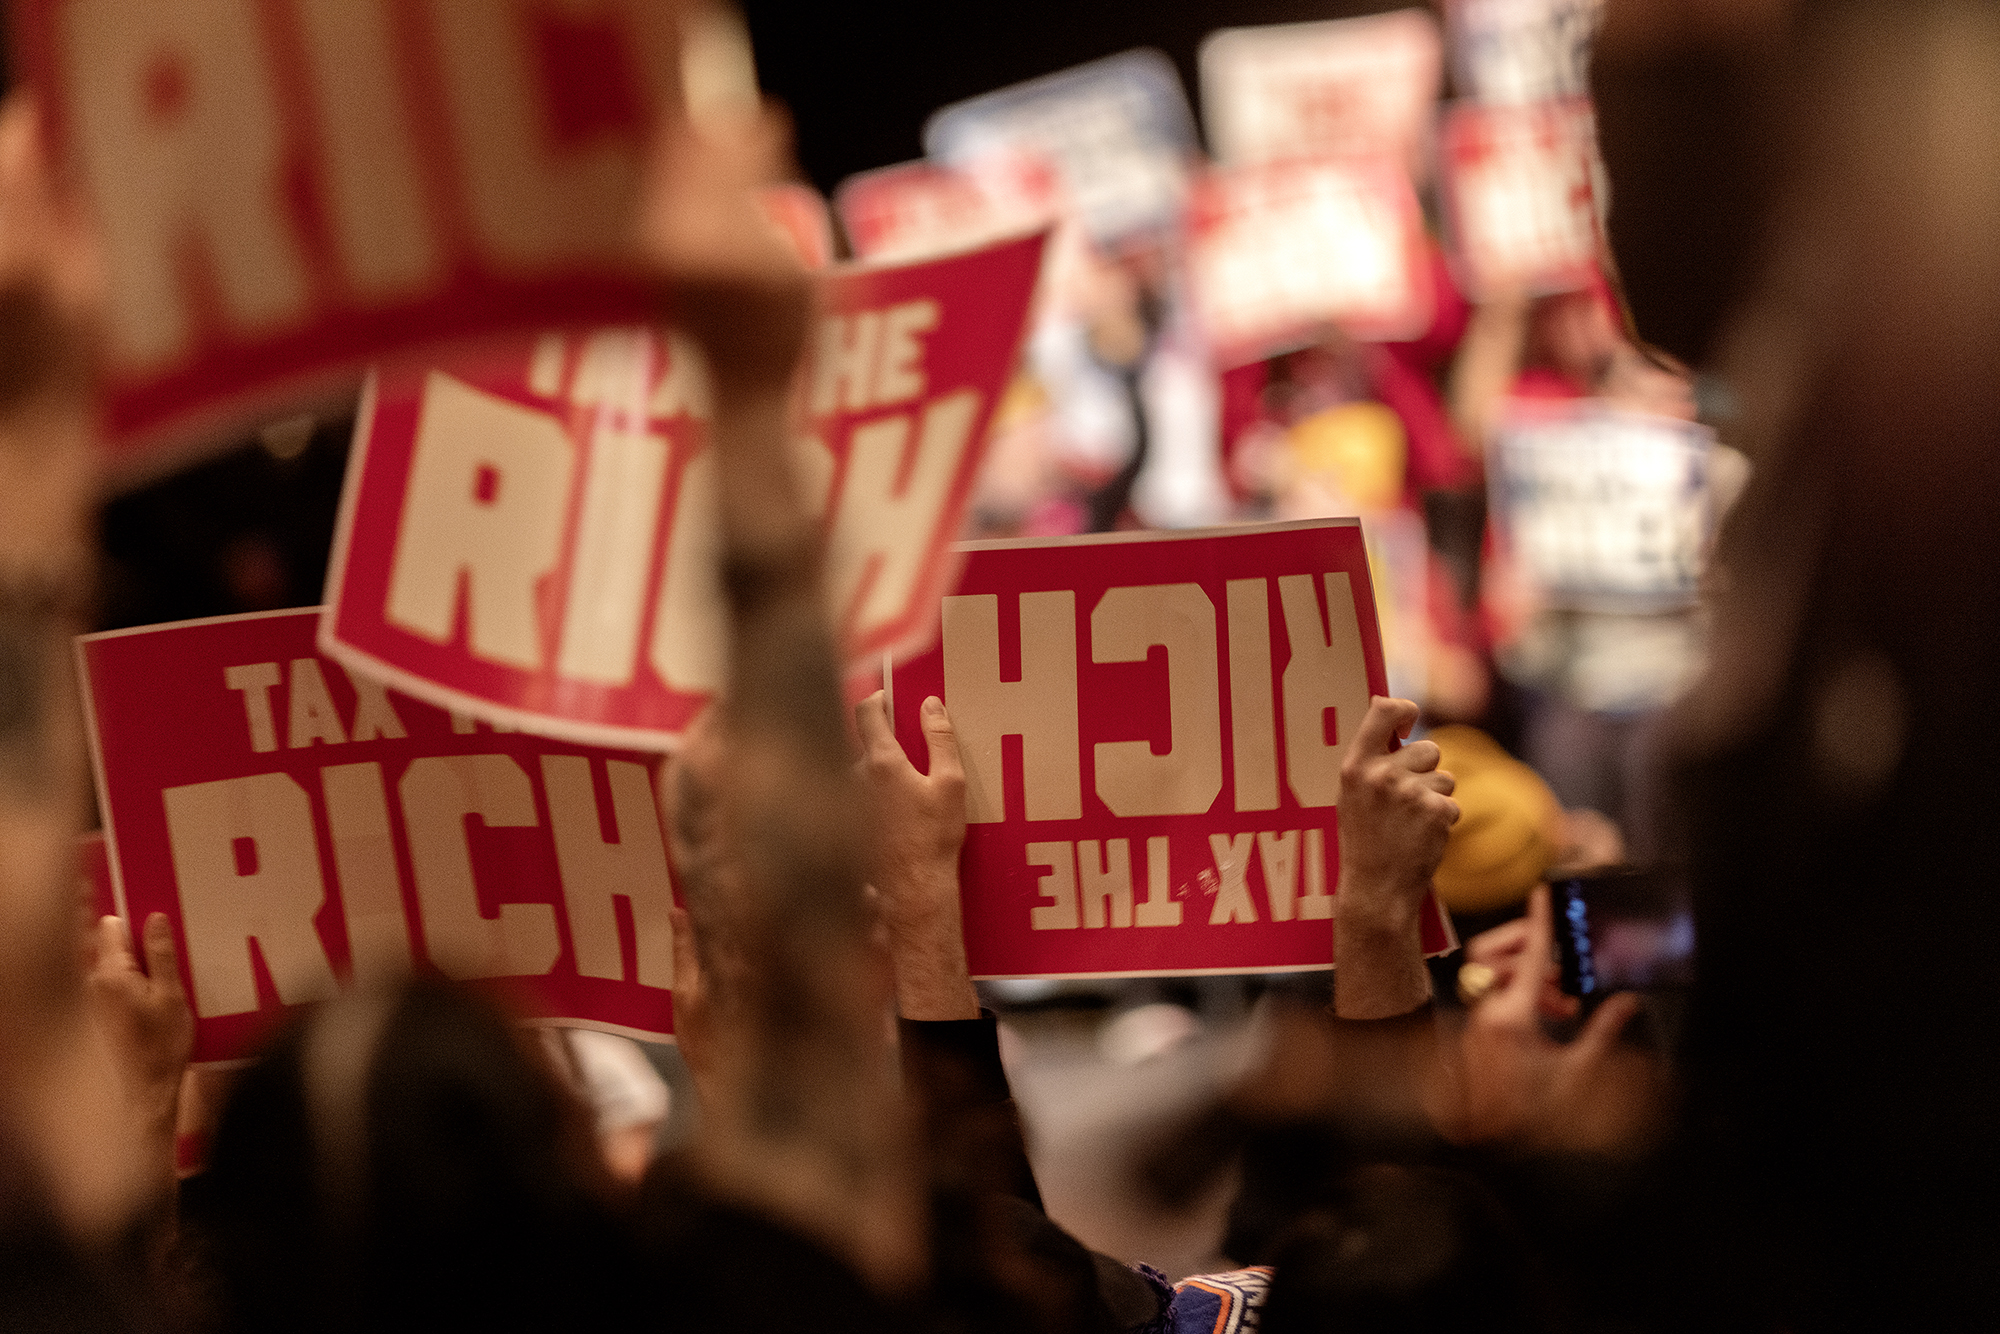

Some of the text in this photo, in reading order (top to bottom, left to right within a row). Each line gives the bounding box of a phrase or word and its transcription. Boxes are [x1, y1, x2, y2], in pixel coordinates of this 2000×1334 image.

[66, 0, 680, 366] RIC
[812, 297, 942, 415] HE
[223, 656, 408, 754] TAX
[942, 571, 1370, 824] RICH
[161, 752, 678, 1020] RICH
[1024, 828, 1338, 932] TAX THE
